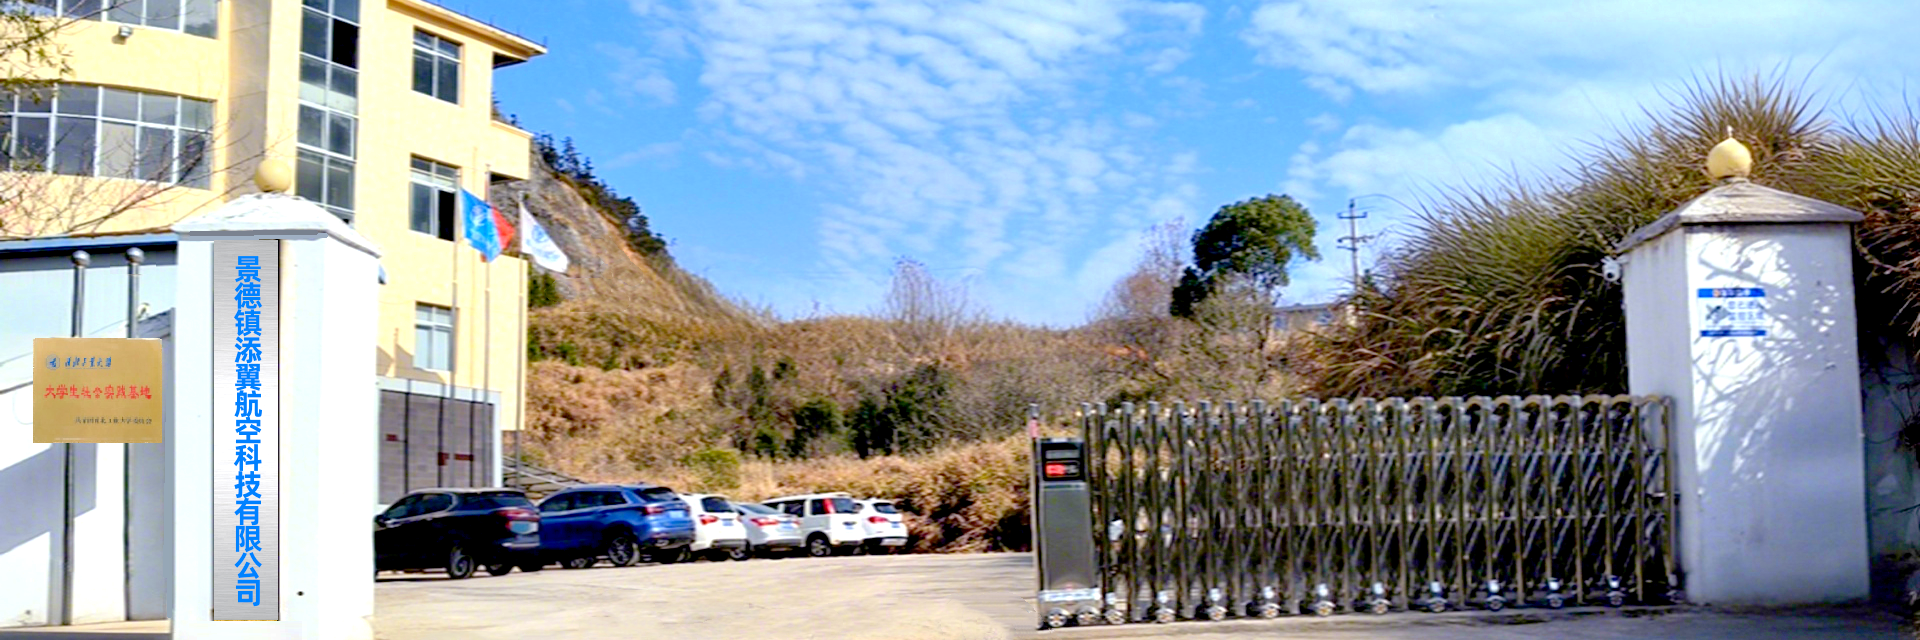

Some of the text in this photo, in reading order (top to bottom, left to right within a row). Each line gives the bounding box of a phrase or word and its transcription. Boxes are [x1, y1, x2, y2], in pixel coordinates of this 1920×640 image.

[43, 384, 152, 400] 大学生社会实践基地
[234, 255, 262, 607] 景德镇添翼航空科技有限公司
